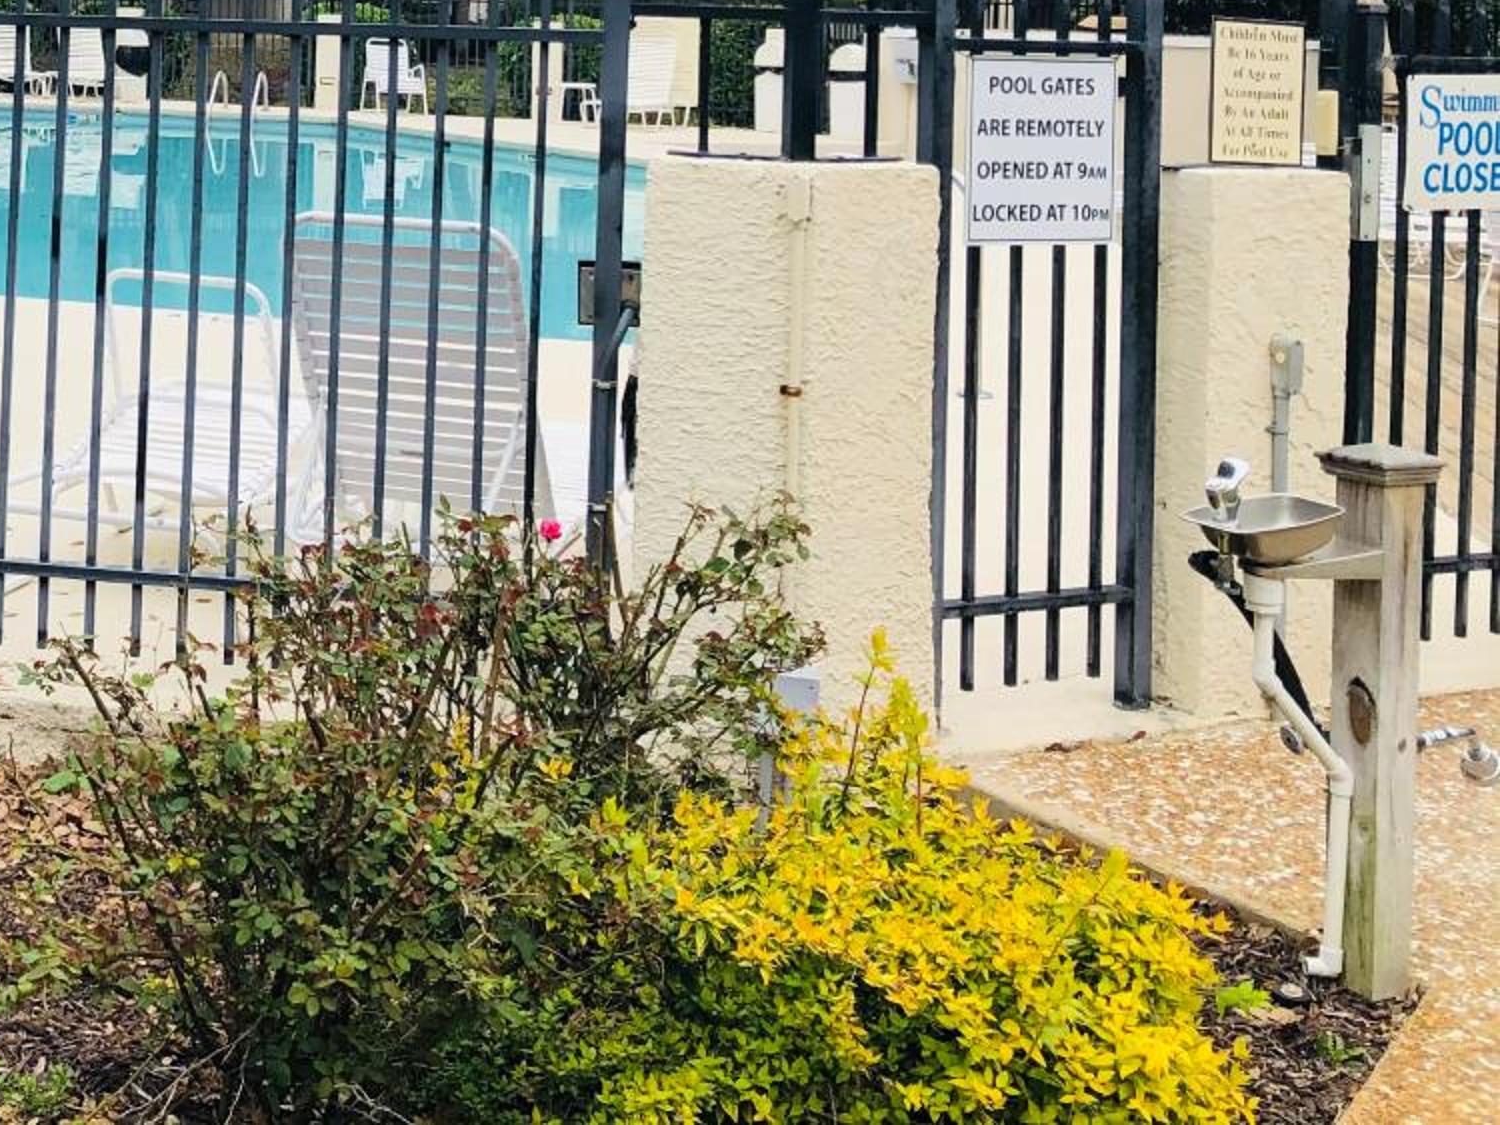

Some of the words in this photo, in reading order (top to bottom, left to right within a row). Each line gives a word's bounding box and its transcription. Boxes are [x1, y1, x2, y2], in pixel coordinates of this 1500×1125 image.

[989, 76, 1036, 94] POOL
[1041, 78, 1095, 96] GATES
[977, 118, 1011, 136] ARE
[1015, 119, 1105, 137] REMOTELY
[977, 161, 1049, 180] OPENED
[1053, 162, 1073, 179] AT
[1077, 163, 1107, 180] 9AM
[973, 204, 1042, 222] LOCKED
[1046, 205, 1067, 221] AT
[1072, 205, 1109, 221] 10PM
